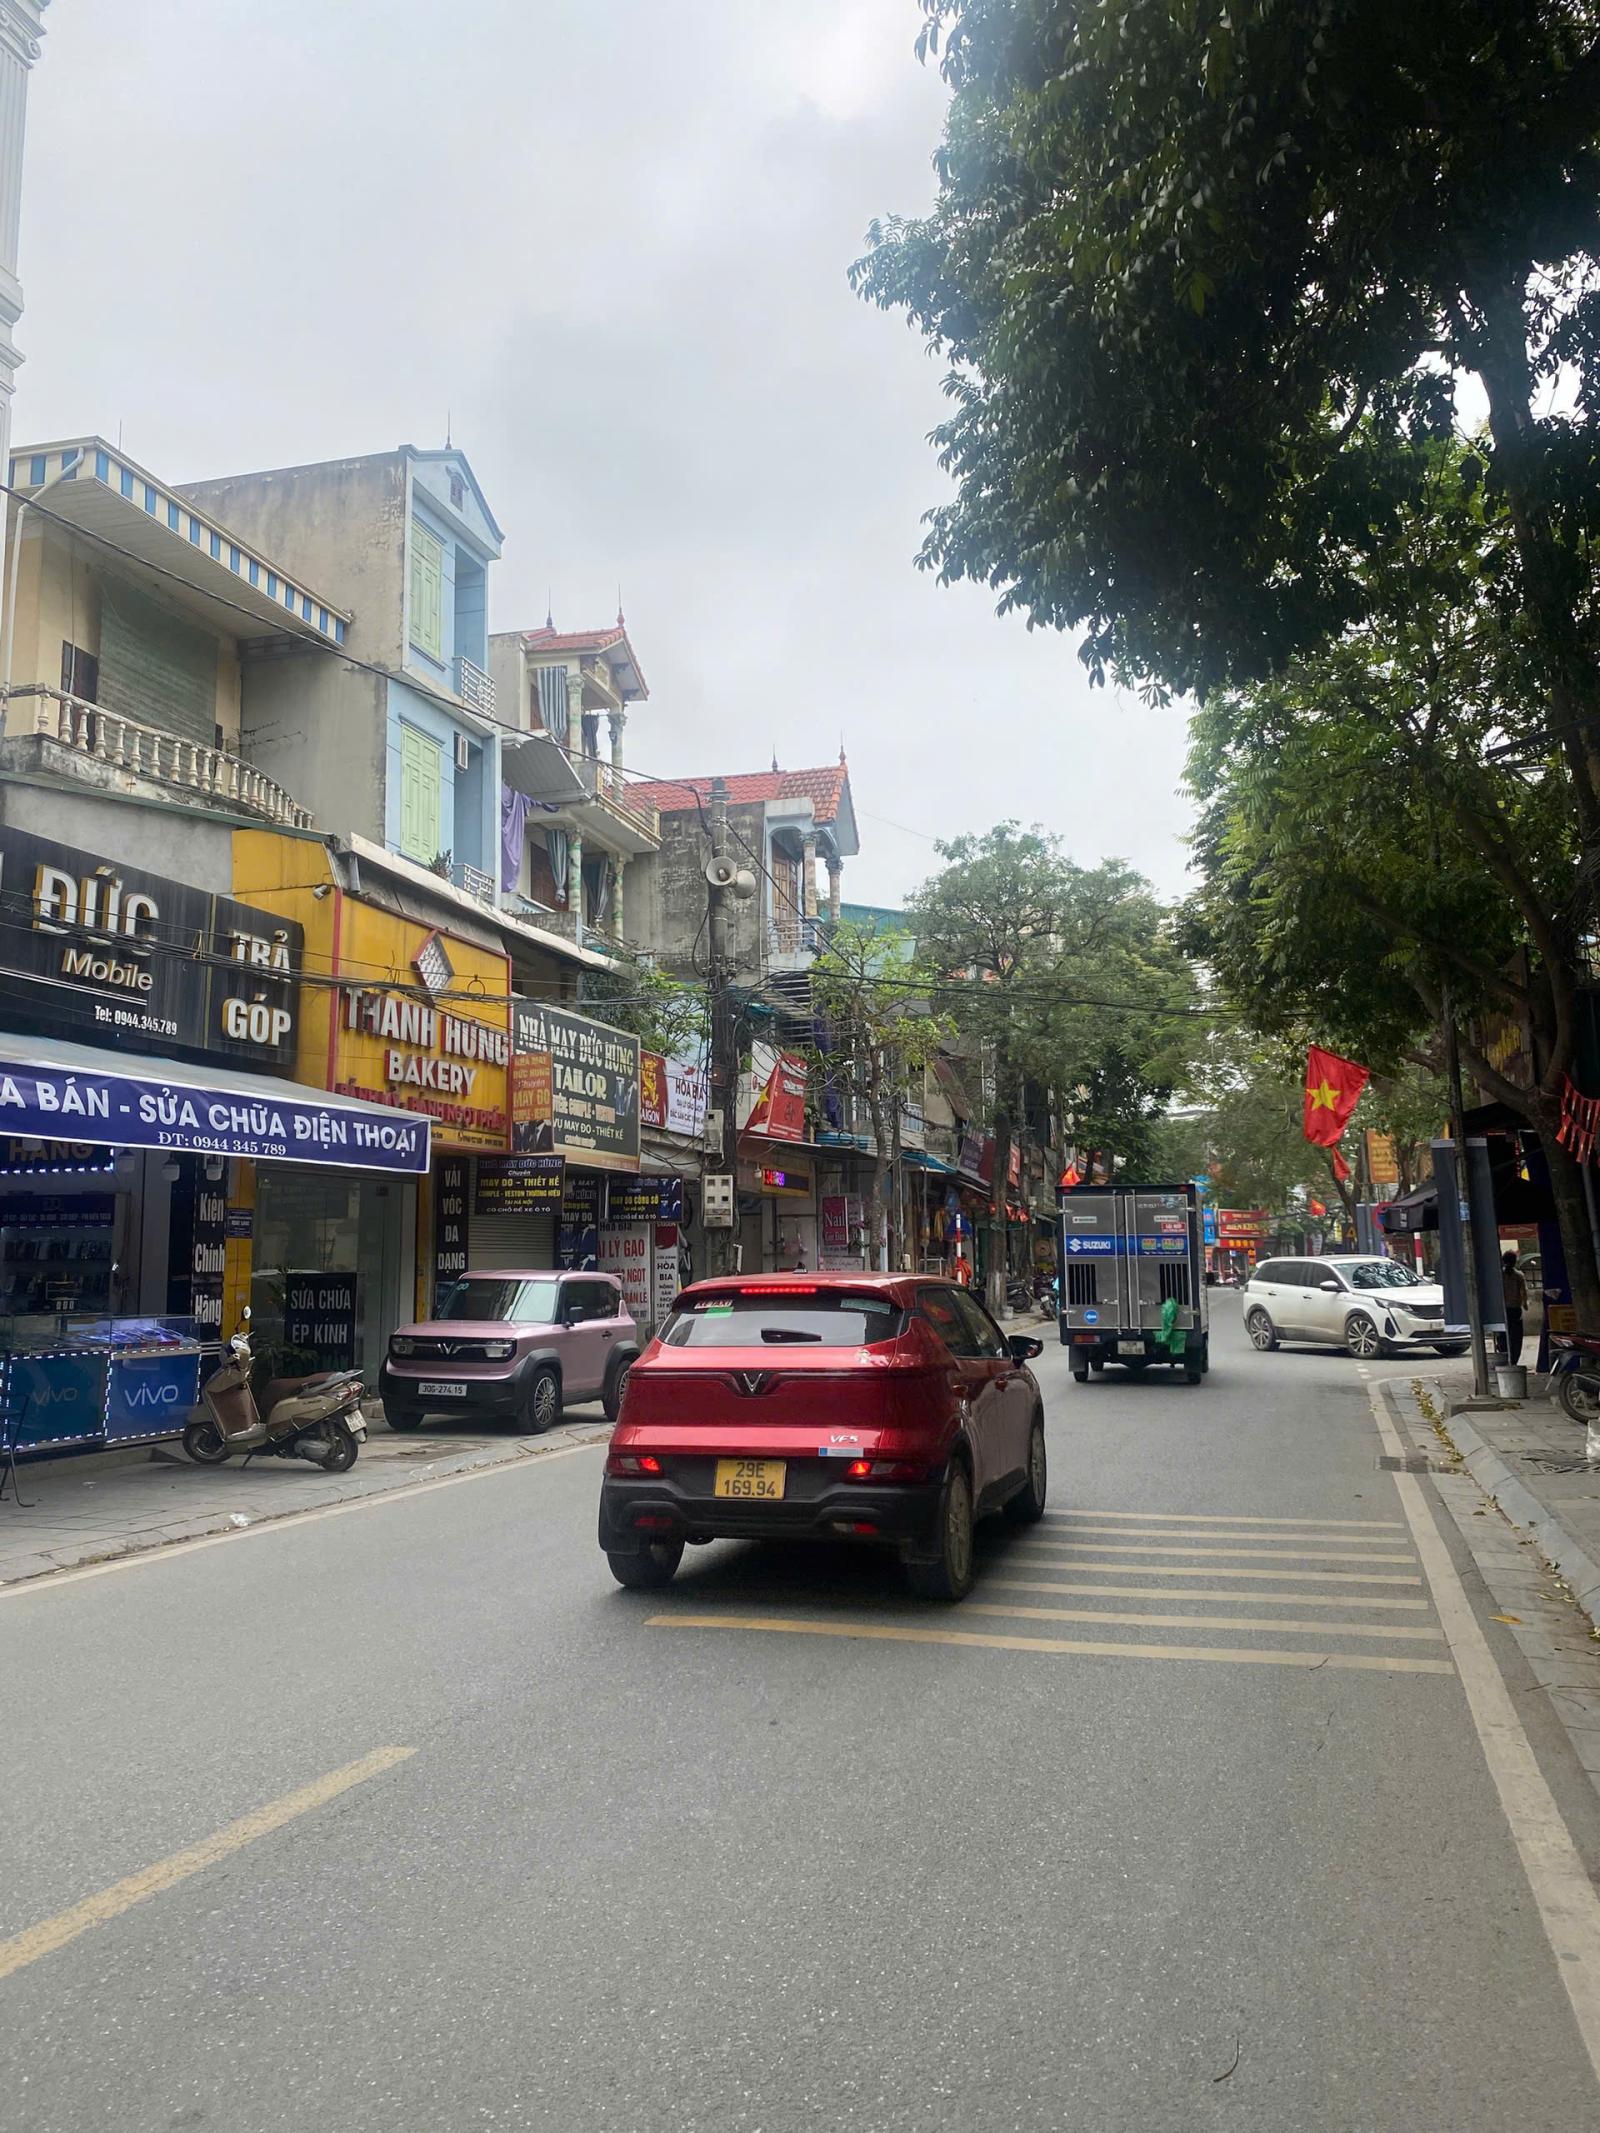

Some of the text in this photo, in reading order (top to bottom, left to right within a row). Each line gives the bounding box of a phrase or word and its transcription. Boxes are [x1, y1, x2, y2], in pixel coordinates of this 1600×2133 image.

[229, 929, 291, 983] TRẢ
[61, 948, 153, 991] Mobile
[95, 1005, 177, 1036] Tel: 0944.345.789
[222, 993, 291, 1047] GÓP
[343, 987, 436, 1048] THANH
[519, 1012, 634, 1077] NHÀ MAY ĐỨC HÙNG
[385, 1049, 477, 1097] BAKERY
[553, 1063, 607, 1100] TAILOR
[36, 1077, 109, 1118] BÁN
[139, 1087, 200, 1128] SỬA
[208, 1101, 287, 1138] CHỮA
[294, 1112, 347, 1150] ĐIỆN
[353, 1122, 416, 1159] THOẠI
[563, 1120, 579, 1132] MAY
[580, 1123, 592, 1135] ĐO
[640, 1110, 660, 1124] AIGON
[157, 1131, 287, 1156] ĐT: 0944 345 789
[480, 1178, 500, 1187] MAY
[200, 1193, 225, 1228] Kiện
[442, 1194, 462, 1215] VÓC
[562, 1211, 580, 1222] MAY
[195, 1242, 226, 1273] Chính
[609, 1237, 621, 1257] LÝ
[623, 1239, 645, 1261] GẠO
[1083, 1241, 1111, 1249] SUZUKI
[437, 1252, 466, 1274] DẠNG
[656, 1260, 675, 1270] HÒA
[626, 1268, 646, 1286] NGỌT
[290, 1282, 351, 1310] SỬA CHỮA
[314, 1317, 348, 1344] KÍNH
[33, 1385, 77, 1407] vivo
[125, 1382, 179, 1408] vivo
[736, 1462, 765, 1478] 29E
[724, 1479, 776, 1497] 169.94
